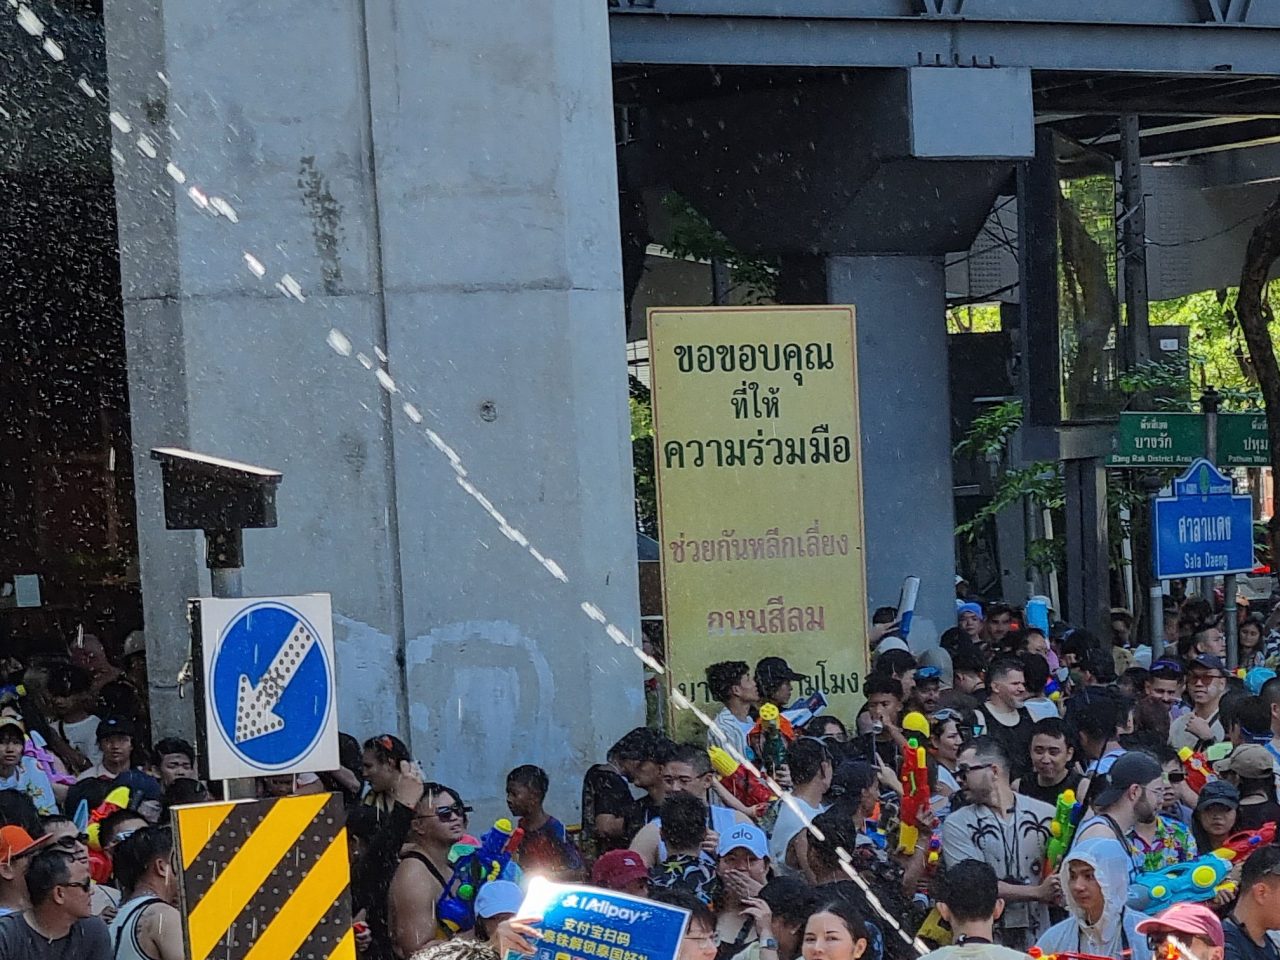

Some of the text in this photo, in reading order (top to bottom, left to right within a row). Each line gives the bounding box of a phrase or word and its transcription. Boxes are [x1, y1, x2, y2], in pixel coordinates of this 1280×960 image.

[673, 341, 834, 387] ขอขอบคุณ
[730, 381, 780, 420] ที่ให้
[663, 422, 851, 469] ความร่วมมือ
[1134, 432, 1173, 450] บางรัก
[1243, 436, 1269, 456] ปทุม
[1112, 454, 1193, 464] Bang Rak District Area
[1228, 455, 1253, 463] Pathum
[668, 520, 850, 564] ช่วยกันหลีกเลี่ยง
[1178, 515, 1232, 545] ศาลาแดง
[1184, 551, 1229, 571] Sala Daeng
[732, 828, 753, 840] alo
[562, 917, 631, 947] 支付宝扫码
